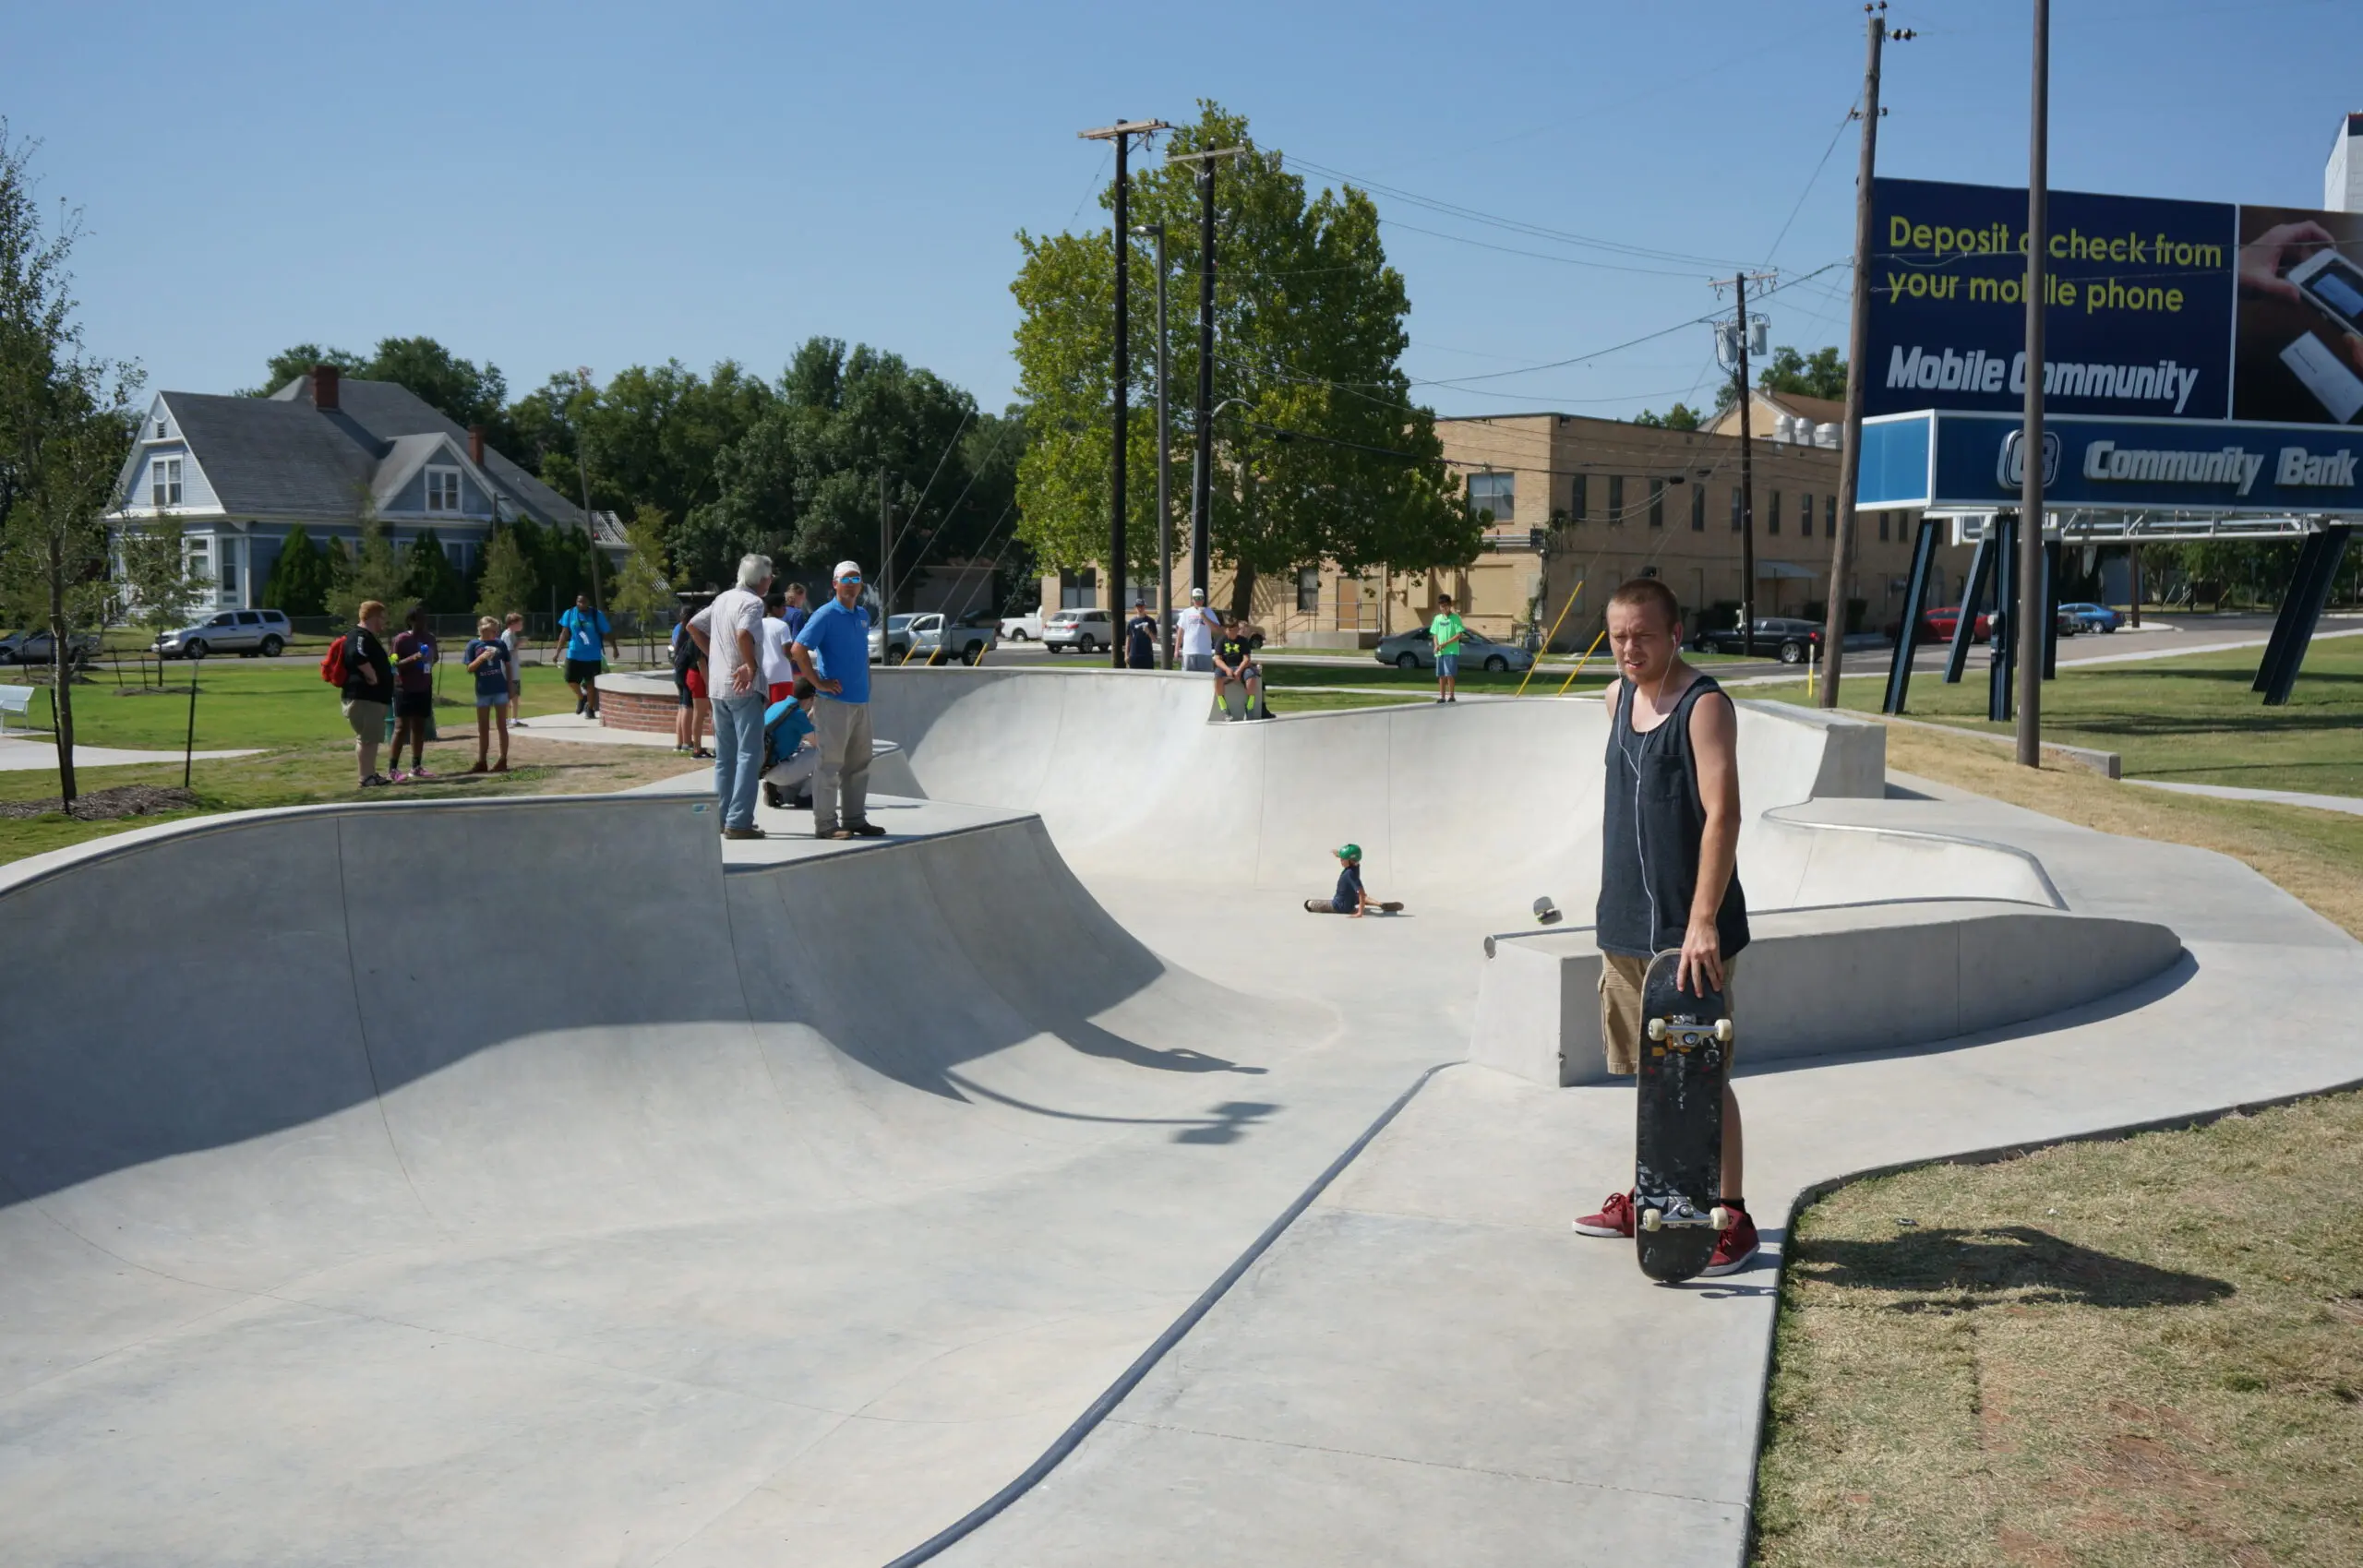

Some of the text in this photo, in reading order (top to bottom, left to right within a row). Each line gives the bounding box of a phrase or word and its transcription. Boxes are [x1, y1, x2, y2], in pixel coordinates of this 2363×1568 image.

[1890, 215, 2009, 257] Deposit
[2049, 228, 2146, 263] check
[2156, 233, 2221, 268] from
[1888, 272, 1960, 304] your
[2087, 277, 2184, 314] phone
[1886, 344, 2006, 393] Mobile
[2083, 440, 2264, 497] Community
[2274, 447, 2358, 486] Bank
